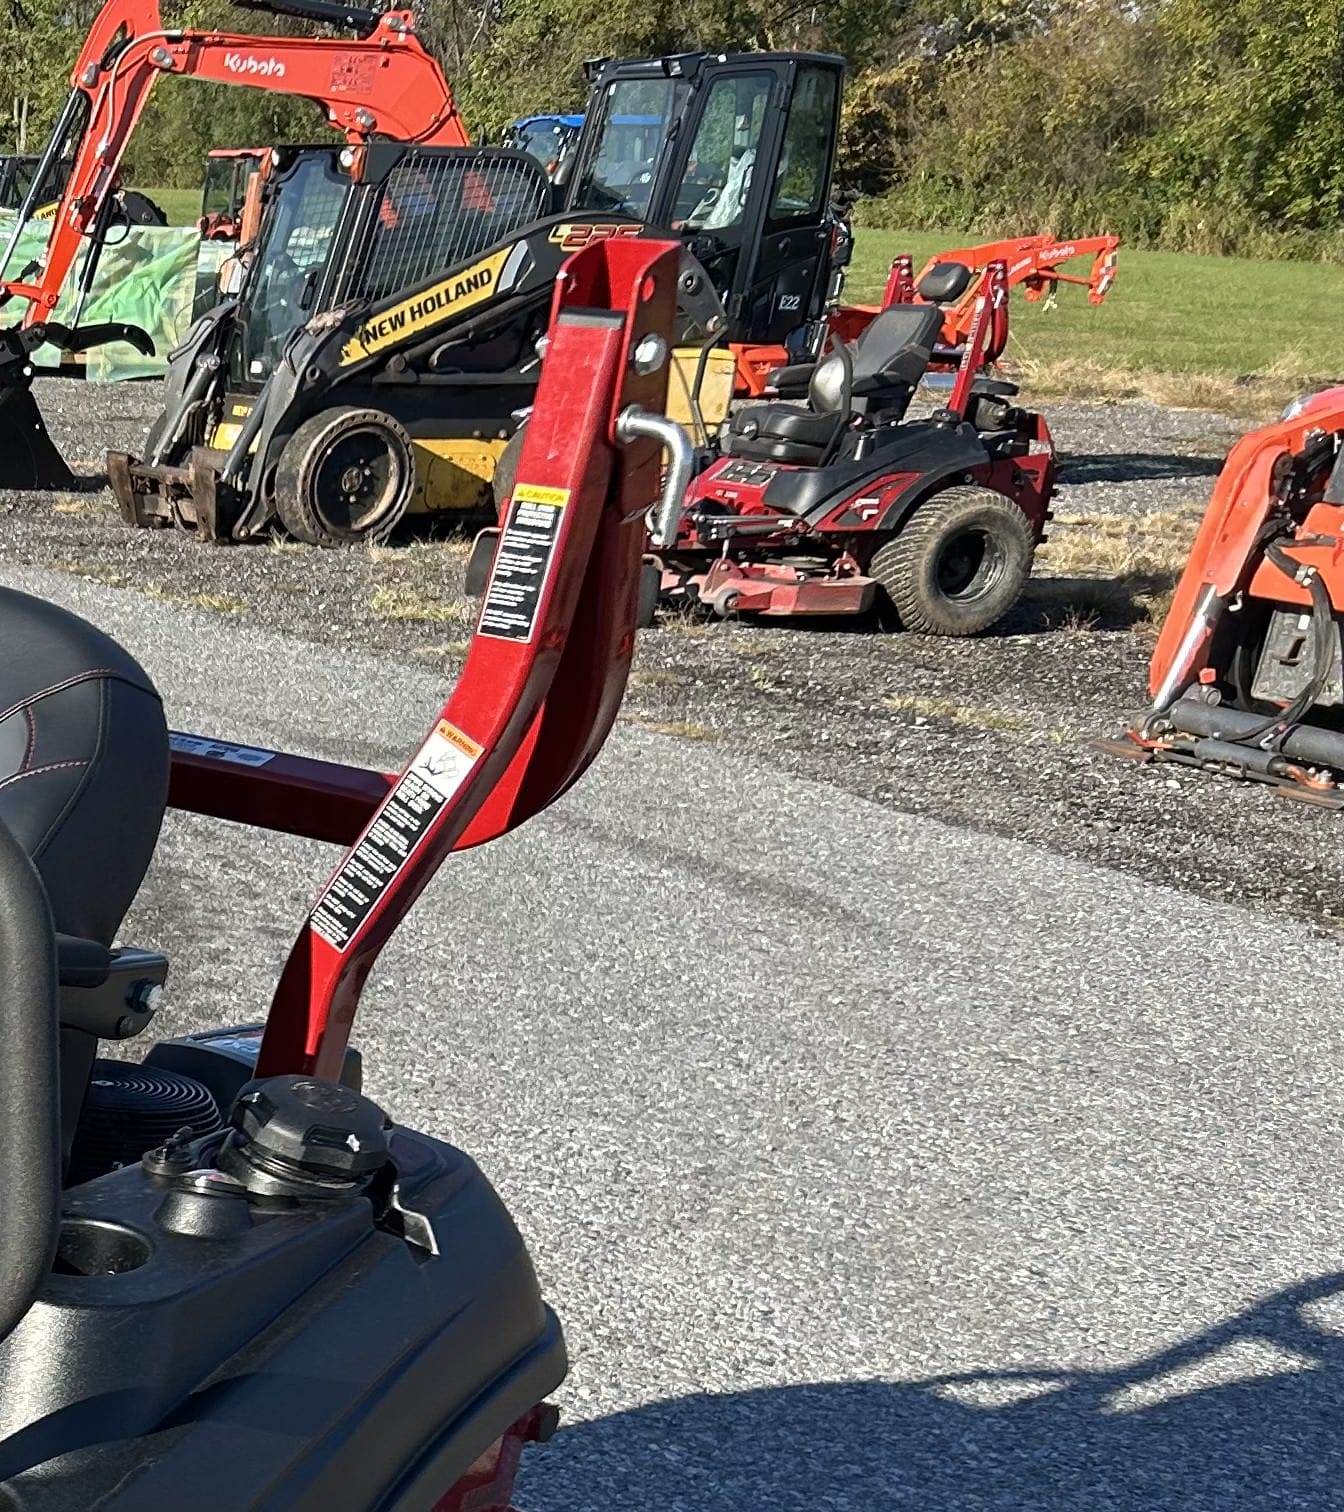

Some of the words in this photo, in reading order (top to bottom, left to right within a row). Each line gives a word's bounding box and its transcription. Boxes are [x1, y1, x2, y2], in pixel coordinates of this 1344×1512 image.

[224, 52, 286, 77] Kubota
[363, 310, 405, 344] NEW
[410, 268, 492, 322] HOLLAND
[778, 295, 800, 310] E22
